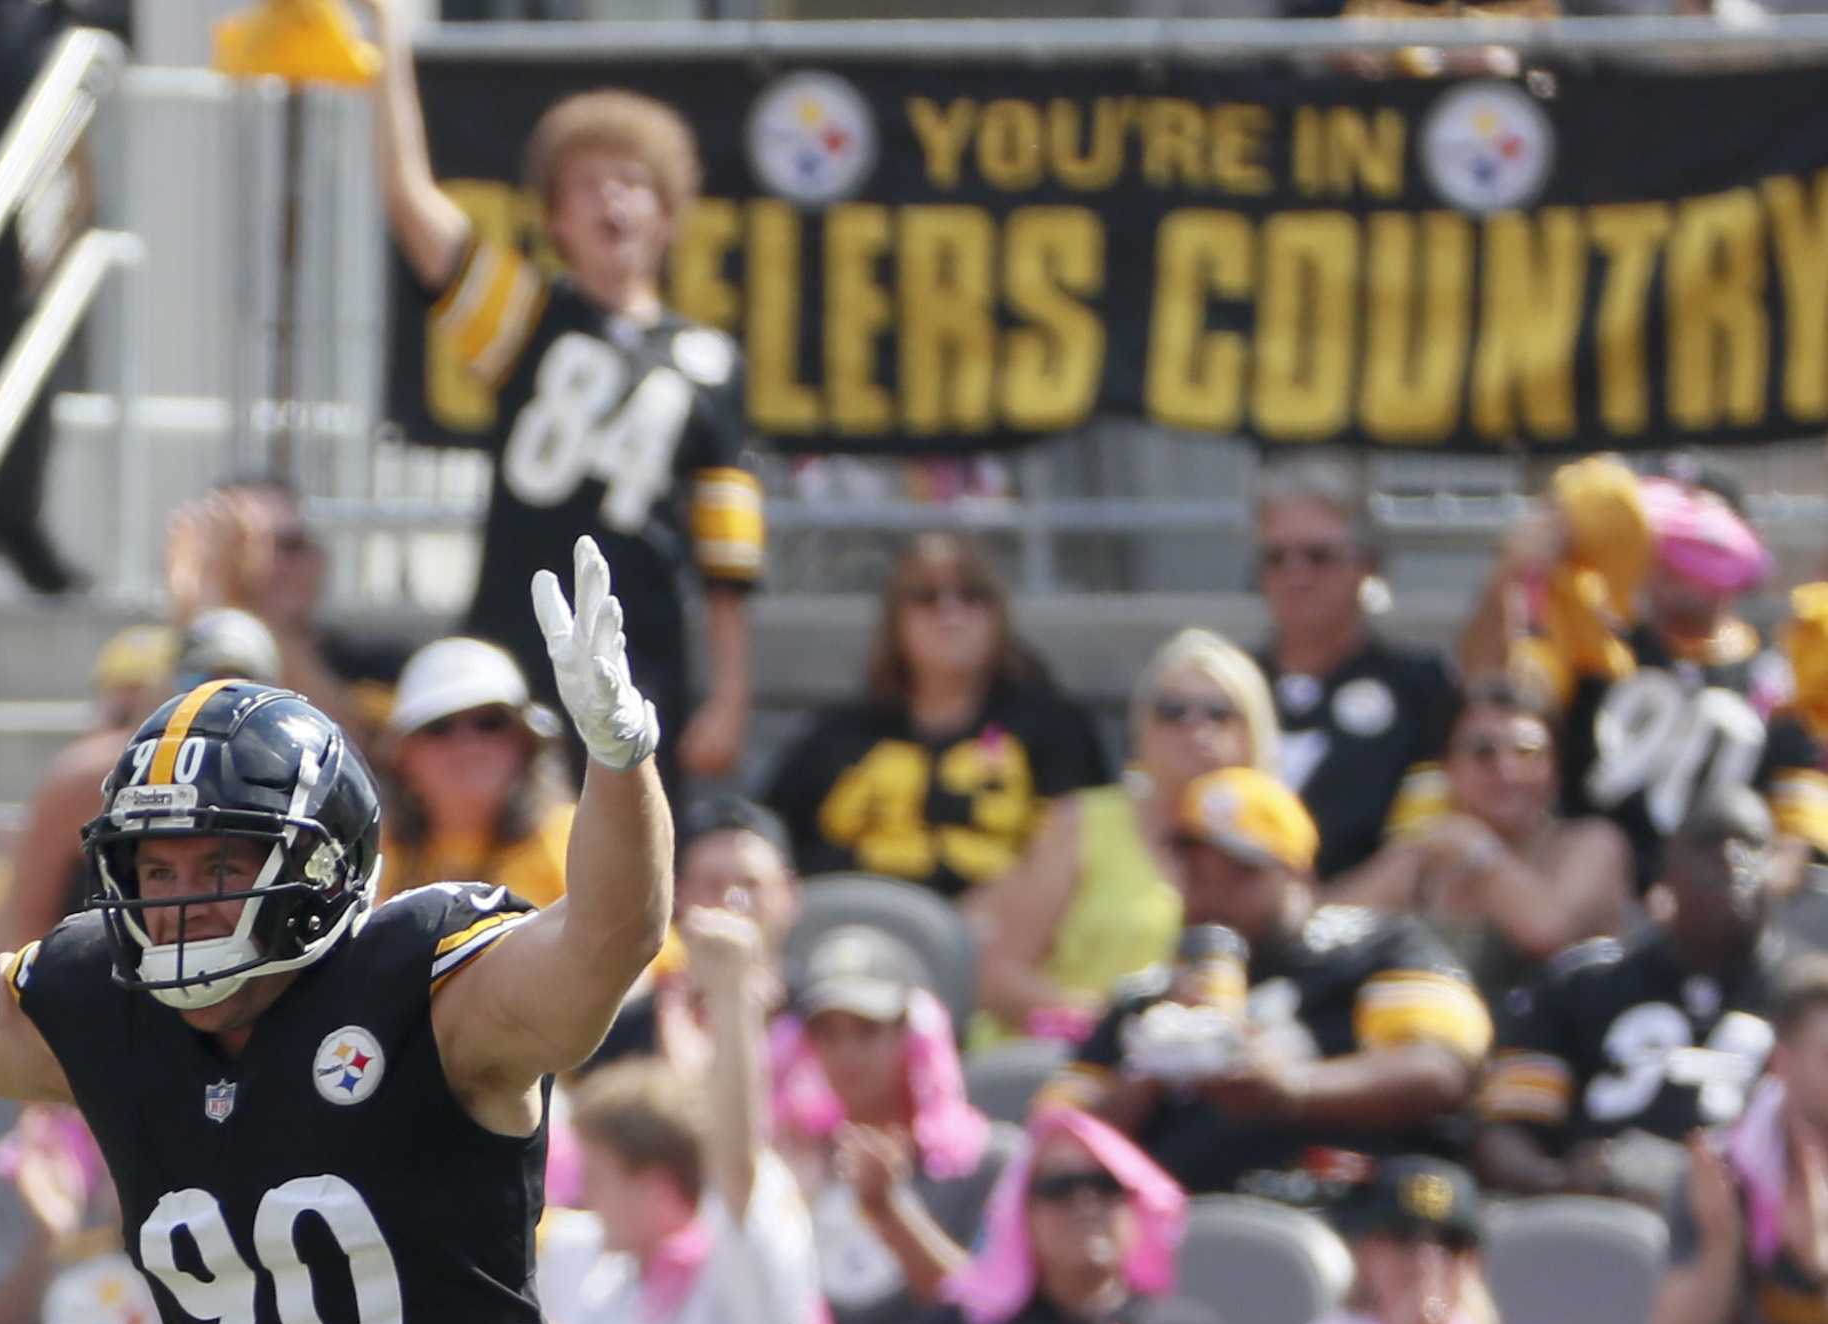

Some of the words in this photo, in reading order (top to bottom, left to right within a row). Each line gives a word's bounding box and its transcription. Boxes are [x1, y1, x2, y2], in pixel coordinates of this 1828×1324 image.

[907, 97, 1271, 192] YOU'RE
[1292, 105, 1407, 196] IN
[427, 178, 1105, 436] SELERS
[503, 332, 694, 534] 84
[129, 737, 205, 785] 90
